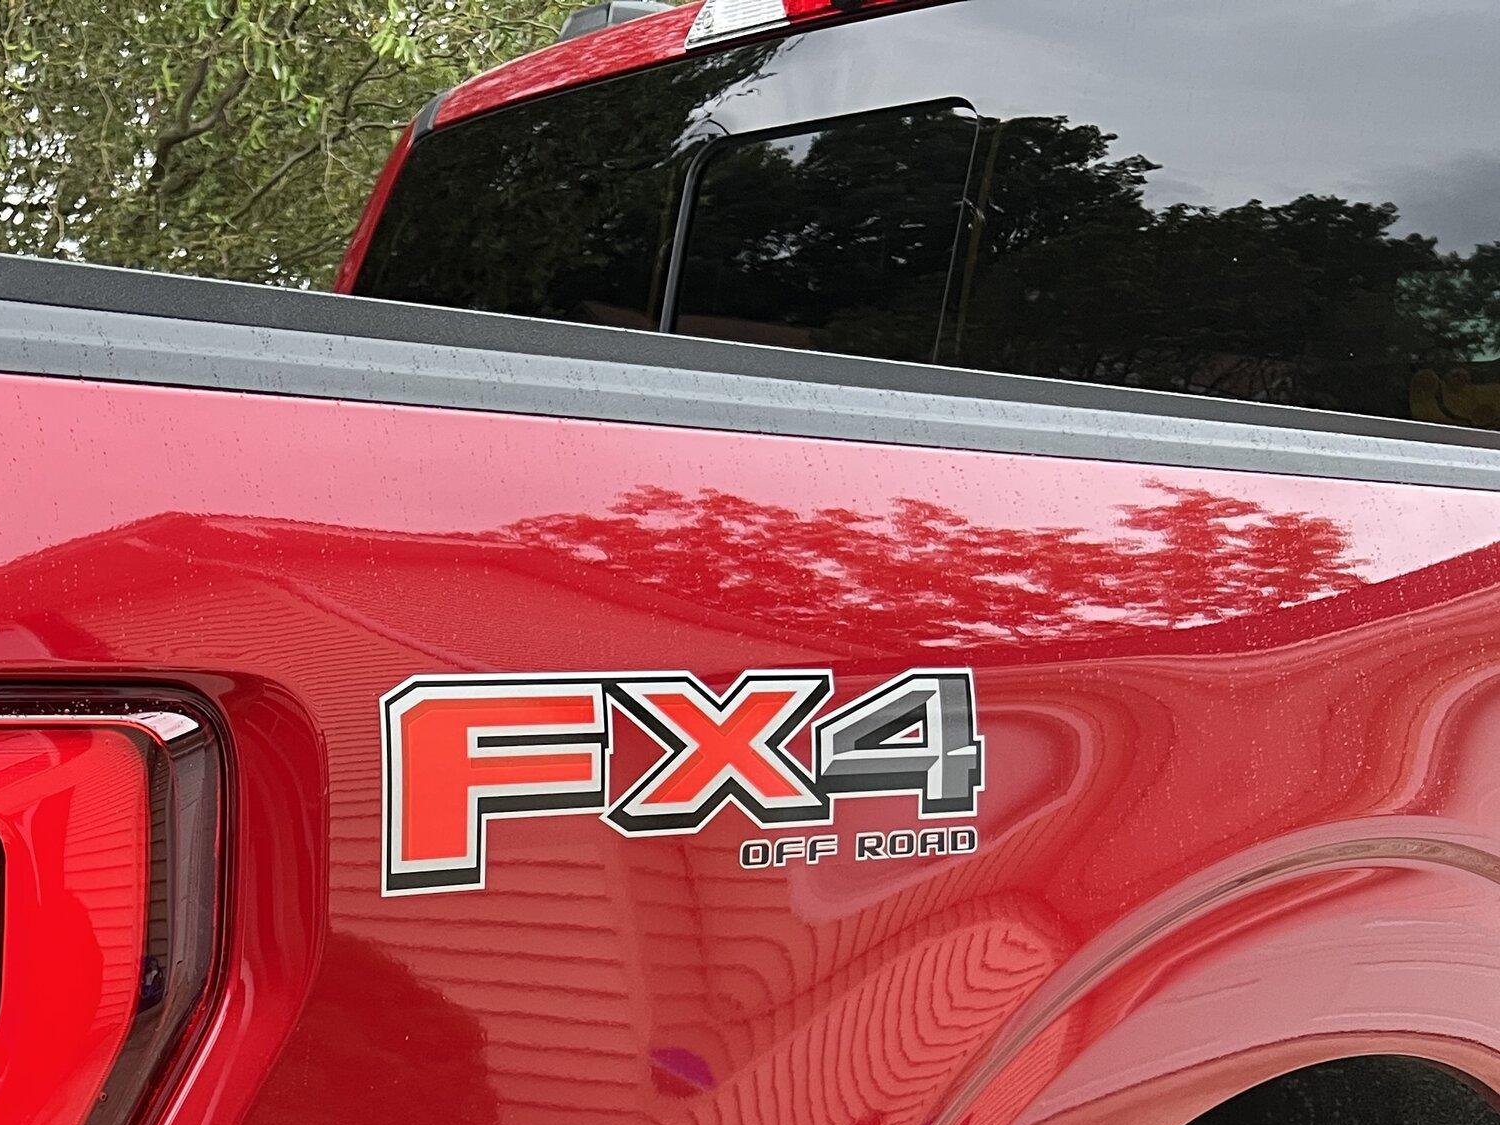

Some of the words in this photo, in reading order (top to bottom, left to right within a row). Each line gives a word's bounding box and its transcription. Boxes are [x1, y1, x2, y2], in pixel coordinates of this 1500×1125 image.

[380, 667, 985, 898] FX4
[739, 834, 838, 870] OFF
[855, 825, 979, 862] ROAD
